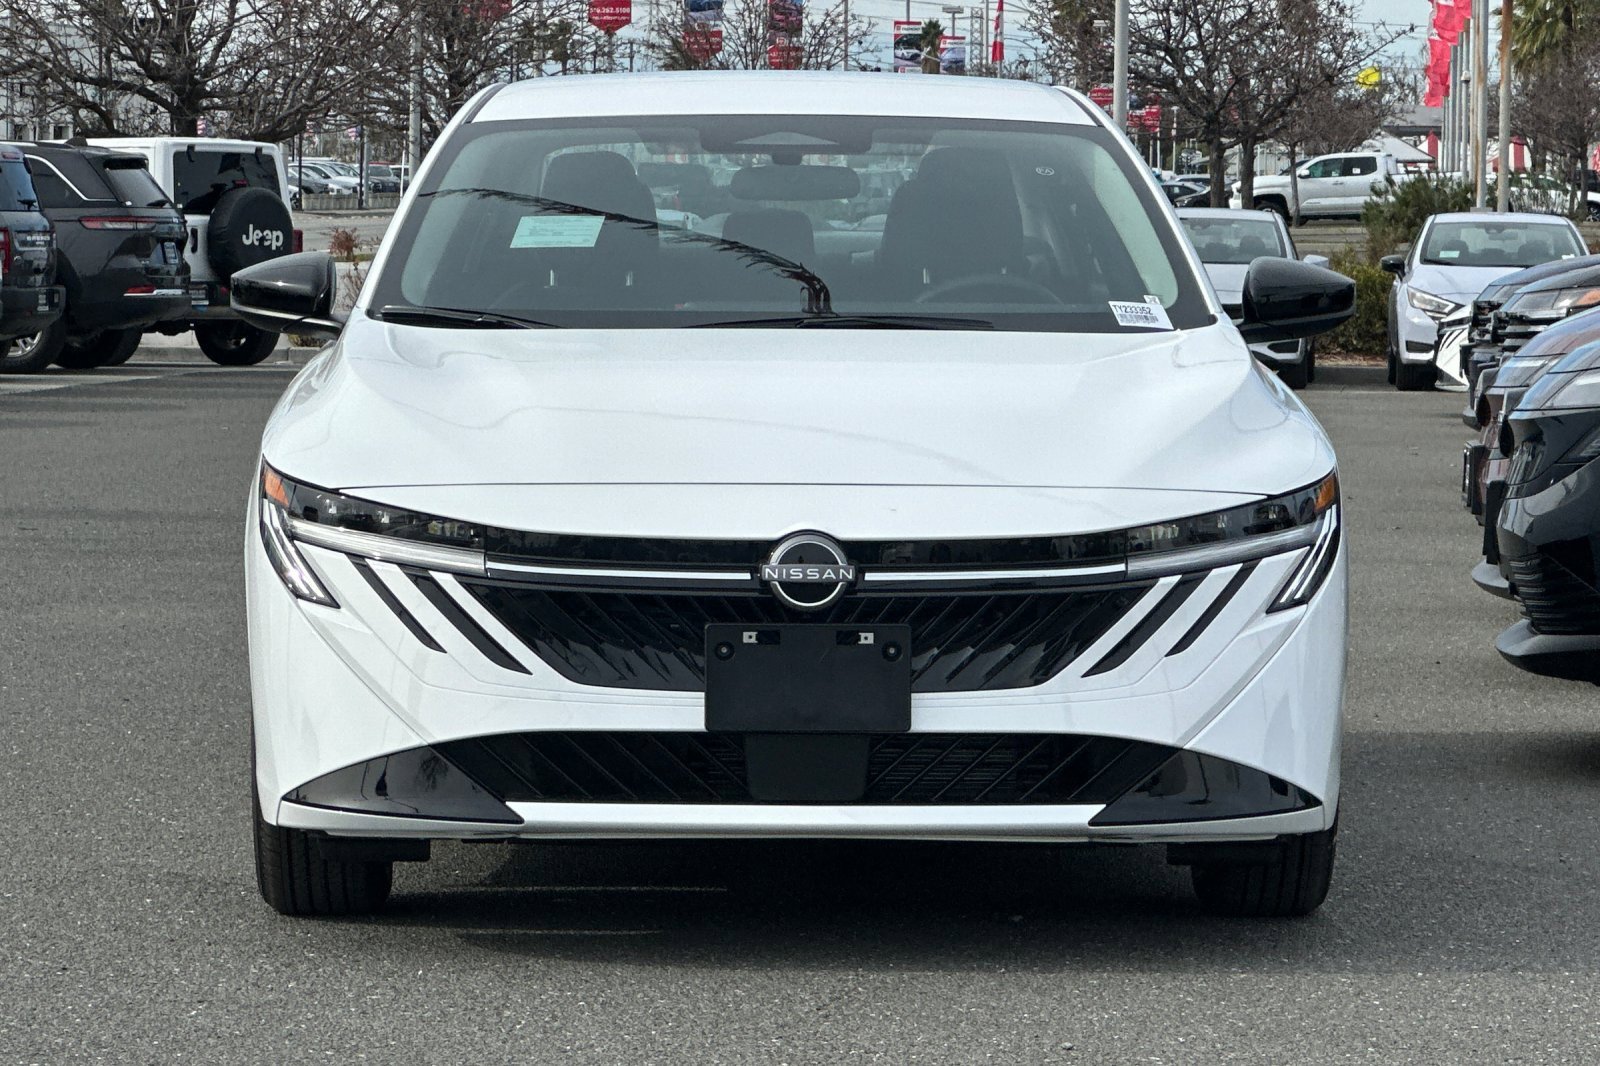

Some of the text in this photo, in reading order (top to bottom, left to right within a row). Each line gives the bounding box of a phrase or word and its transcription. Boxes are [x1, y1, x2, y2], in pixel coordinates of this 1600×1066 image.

[241, 223, 284, 251] Jeep
[1111, 304, 1153, 315] TY233352
[765, 568, 853, 580] NISSAN
